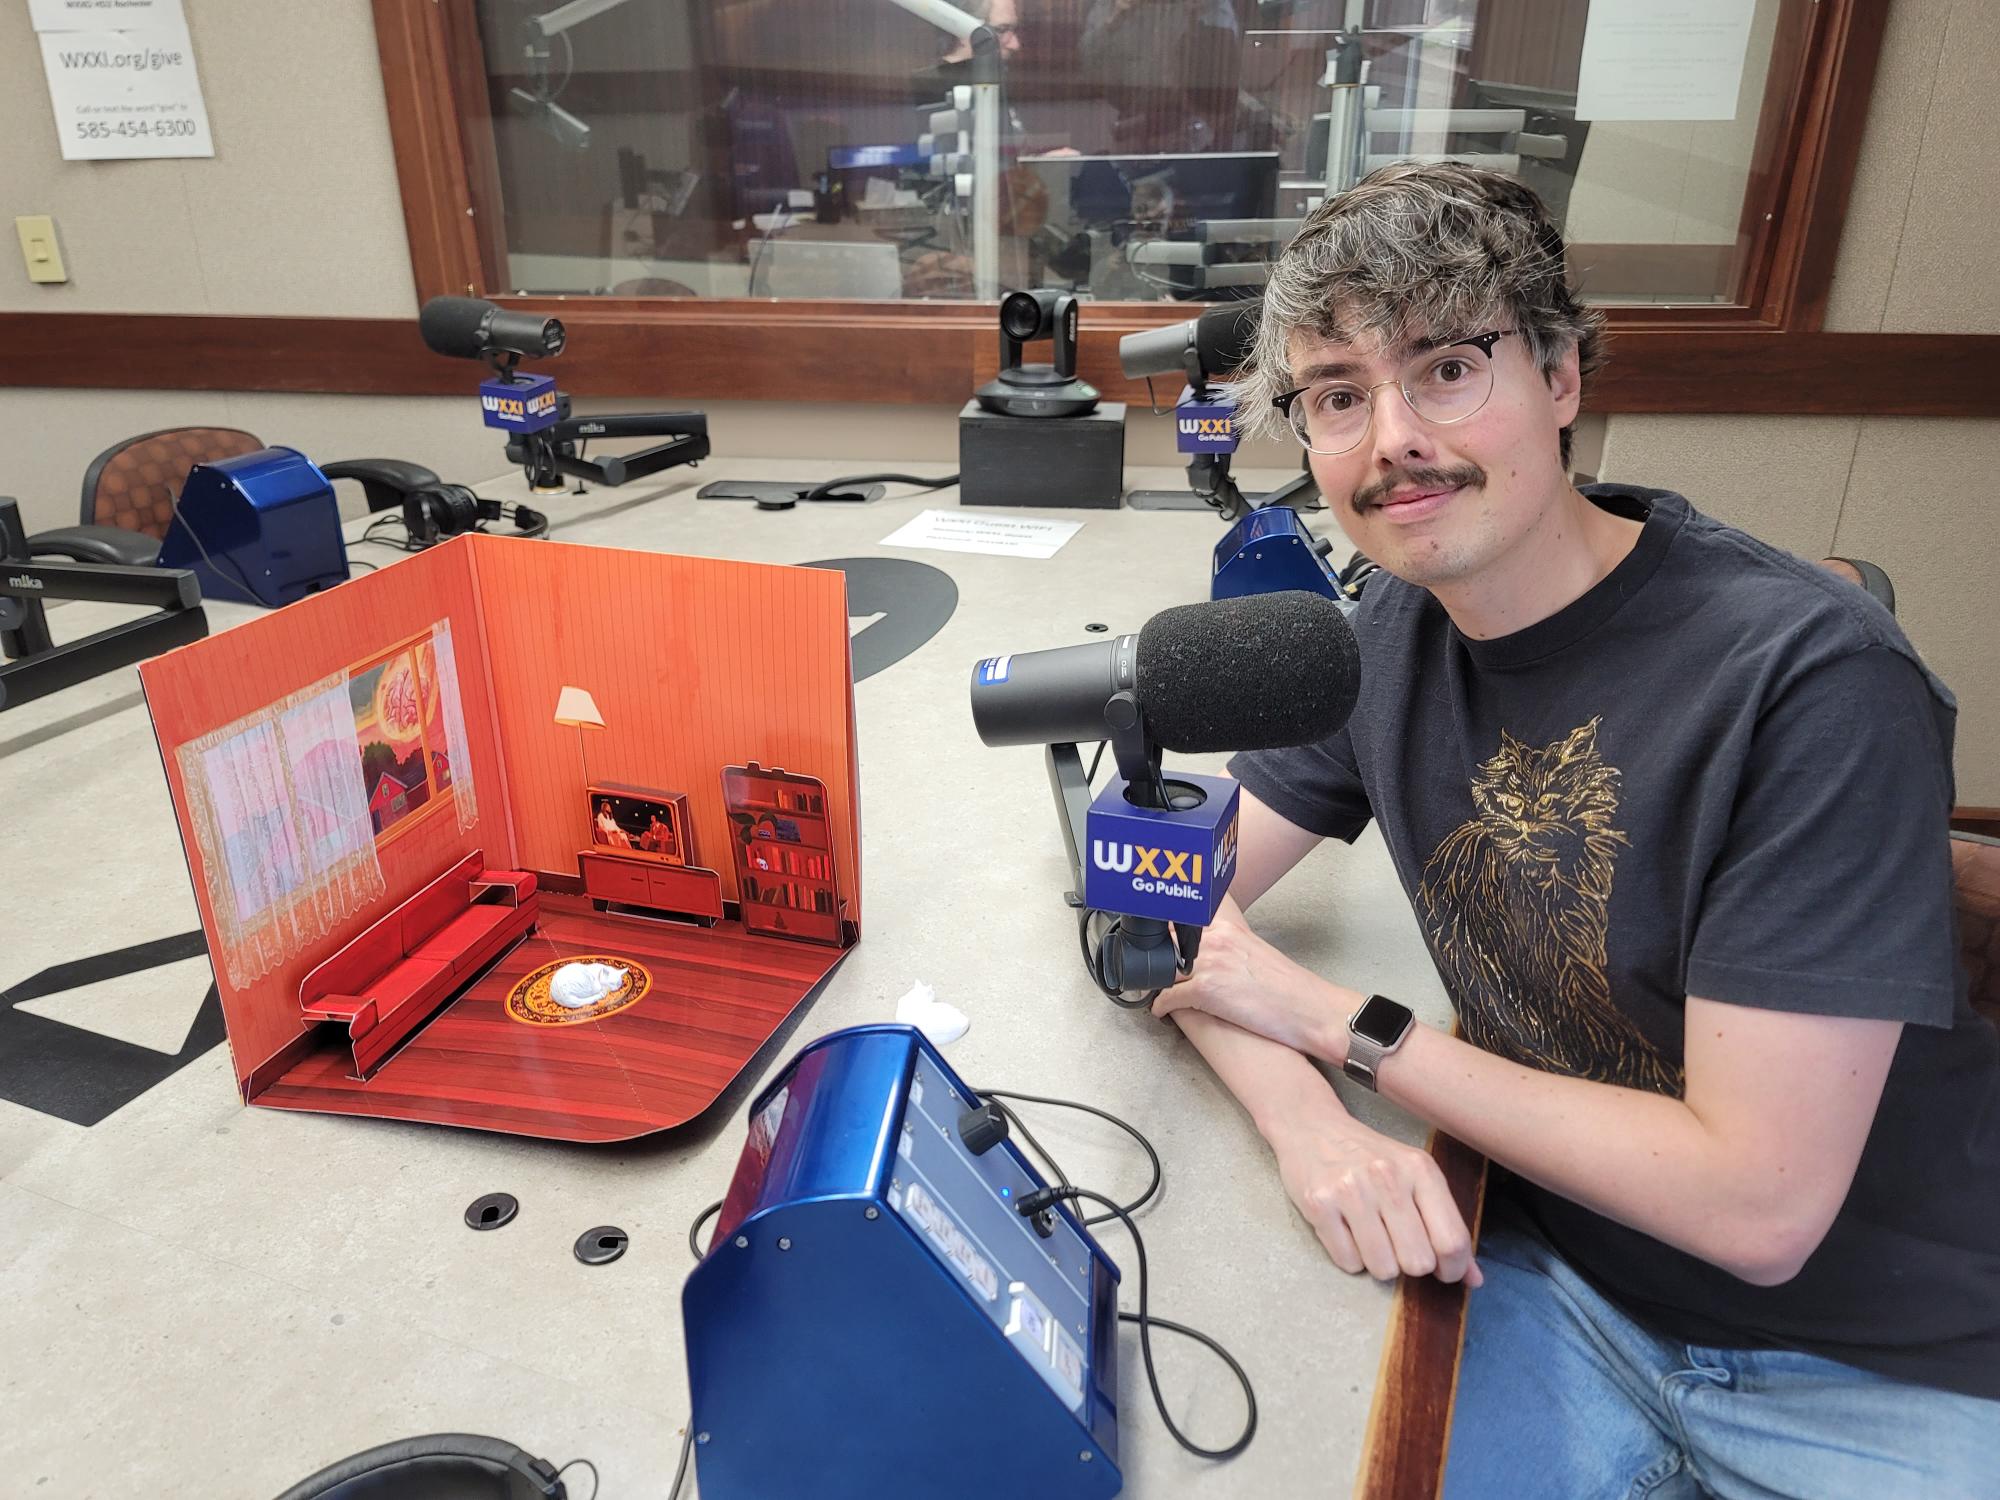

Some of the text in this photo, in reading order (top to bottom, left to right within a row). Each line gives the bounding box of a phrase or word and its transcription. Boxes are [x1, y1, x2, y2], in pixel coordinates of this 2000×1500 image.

[59, 48, 183, 71] WXXI.org/give
[76, 119, 196, 139] 585-454-6300
[482, 395, 524, 415] WXXI
[526, 390, 556, 415] WXXI
[1178, 418, 1231, 434] WXXI
[9, 574, 43, 589] mika
[1093, 839, 1203, 884] WXXI
[1132, 877, 1203, 901] Go Public.
